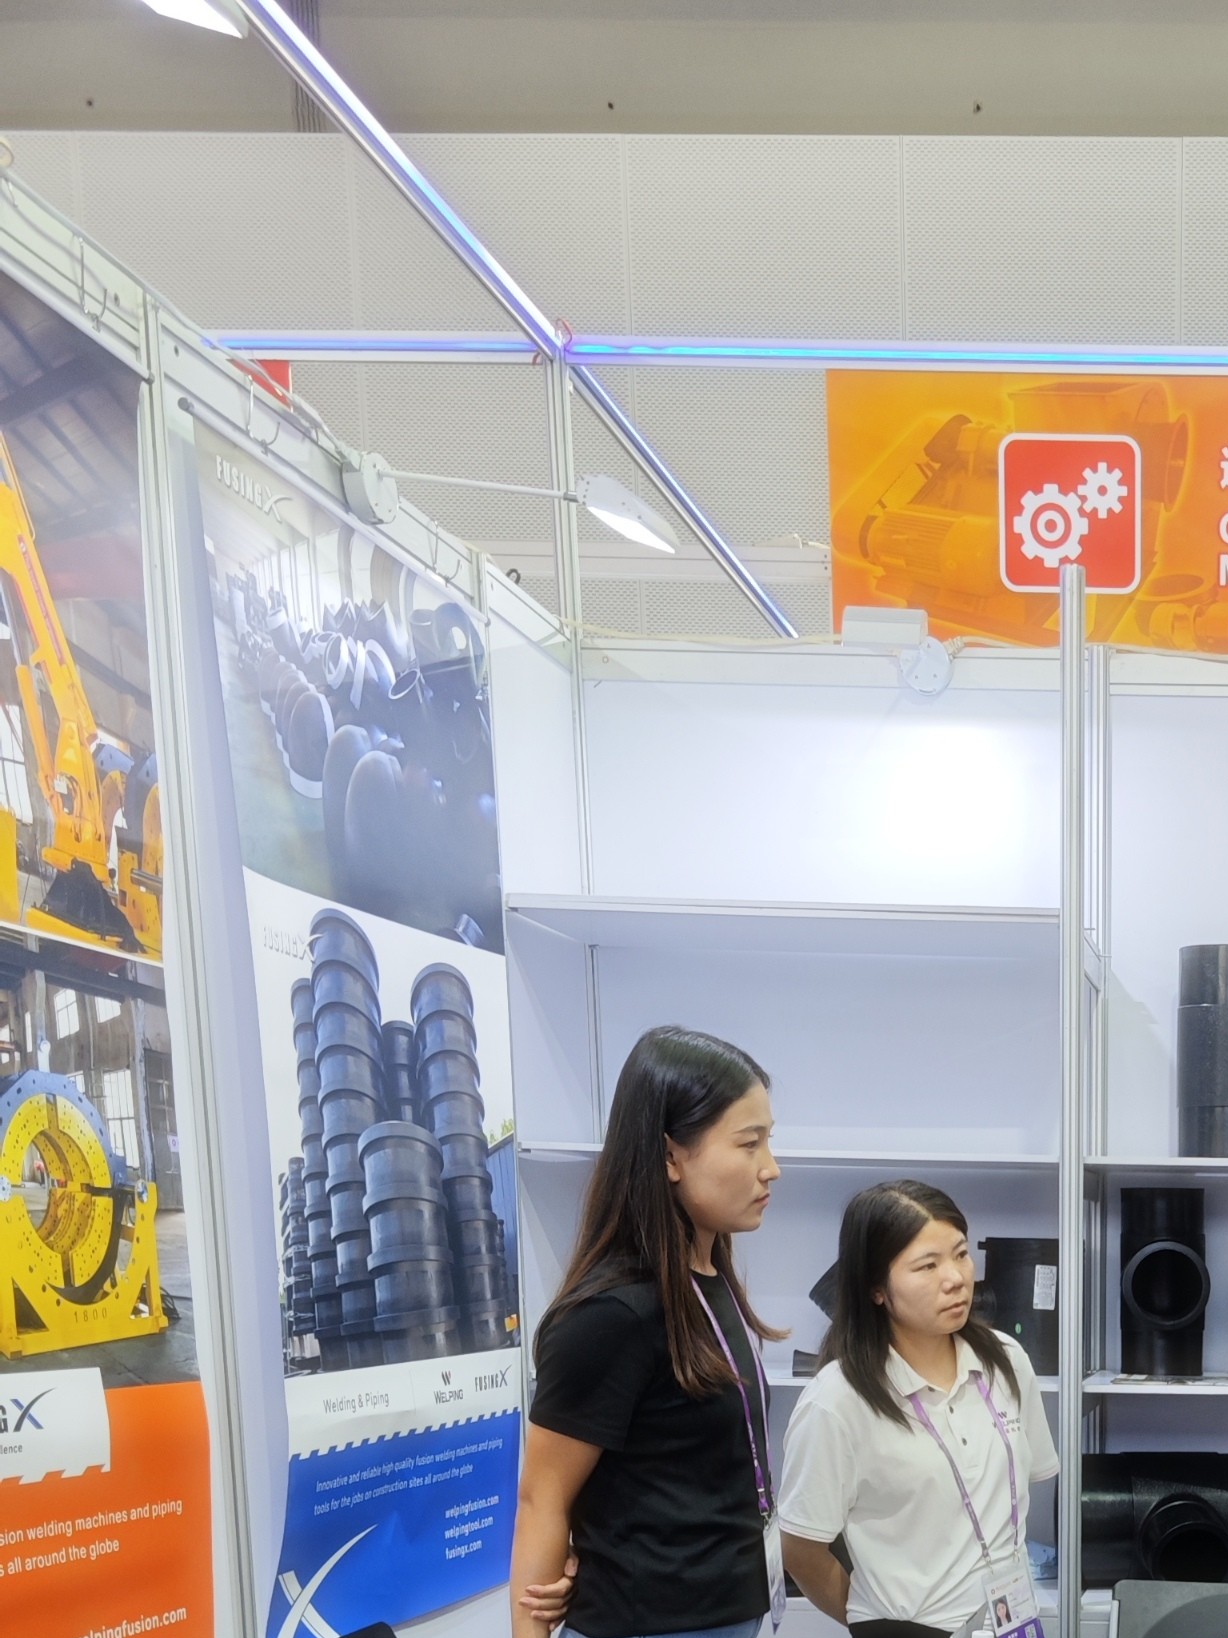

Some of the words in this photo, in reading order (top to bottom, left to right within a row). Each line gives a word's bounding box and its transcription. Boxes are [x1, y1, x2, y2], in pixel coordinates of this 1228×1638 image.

[216, 454, 293, 524] FUSINGX
[74, 1307, 107, 1323] 1800
[475, 1364, 512, 1392] FUSINGX
[323, 1395, 357, 1414] Welding
[358, 1394, 364, 1408] &
[365, 1392, 390, 1409] Piping
[434, 1389, 464, 1405] WELPING
[316, 1475, 348, 1492] Innovative
[349, 1470, 360, 1484] and
[361, 1465, 381, 1480] reliable
[382, 1461, 394, 1476] high
[394, 1457, 414, 1472] quality
[416, 1453, 434, 1466] fusion
[435, 1449, 455, 1461] welding
[456, 1443, 478, 1457] machines
[478, 1439, 488, 1451] and
[488, 1437, 503, 1451] piping
[314, 1501, 329, 1516] tools
[331, 1498, 341, 1510] for
[341, 1495, 351, 1508] the
[350, 1491, 364, 1508] jobs
[364, 1490, 372, 1500] on
[372, 1478, 407, 1498] construction
[409, 1474, 423, 1488] sites
[432, 1468, 450, 1483] around
[451, 1467, 460, 1478] the
[460, 1463, 473, 1478] globe
[26, 1522, 73, 1540] welding
[75, 1510, 128, 1532] machines
[130, 1503, 150, 1521] and
[151, 1498, 183, 1519] piping
[445, 1495, 499, 1519] welpingfusion.com
[444, 1516, 494, 1539] welpingtool.com
[7, 1557, 22, 1575] all
[25, 1548, 66, 1571] around
[69, 1545, 87, 1562] the
[89, 1538, 120, 1560] globe
[445, 1539, 482, 1560] fusingx.com
